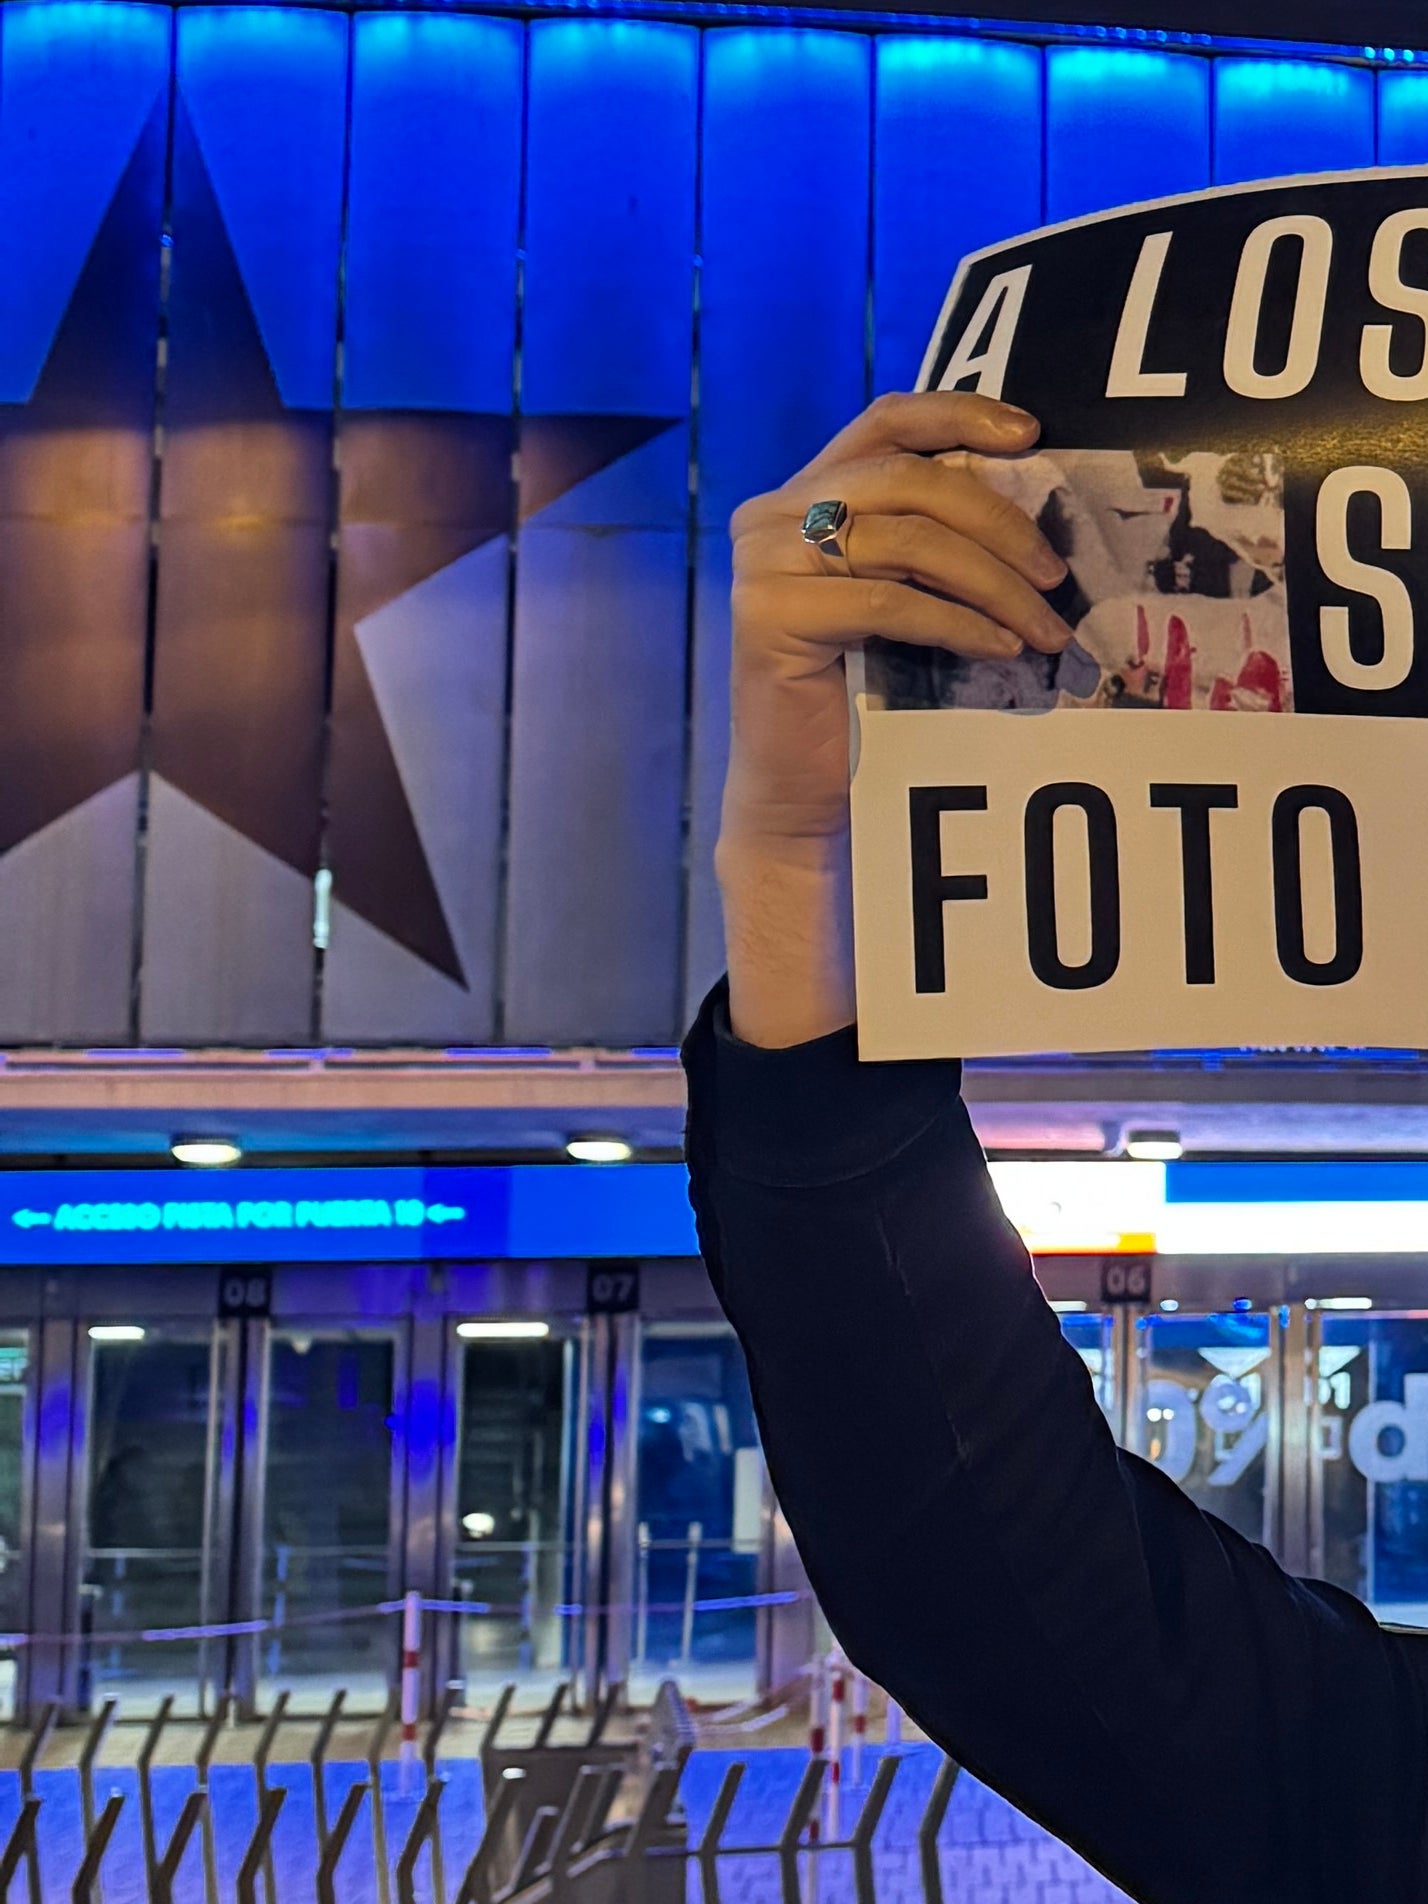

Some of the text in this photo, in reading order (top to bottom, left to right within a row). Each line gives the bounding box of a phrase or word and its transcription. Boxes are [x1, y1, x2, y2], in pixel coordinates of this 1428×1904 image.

[930, 263, 1033, 401] A
[909, 781, 1365, 996] FOTO
[1107, 1267, 1146, 1293] 06
